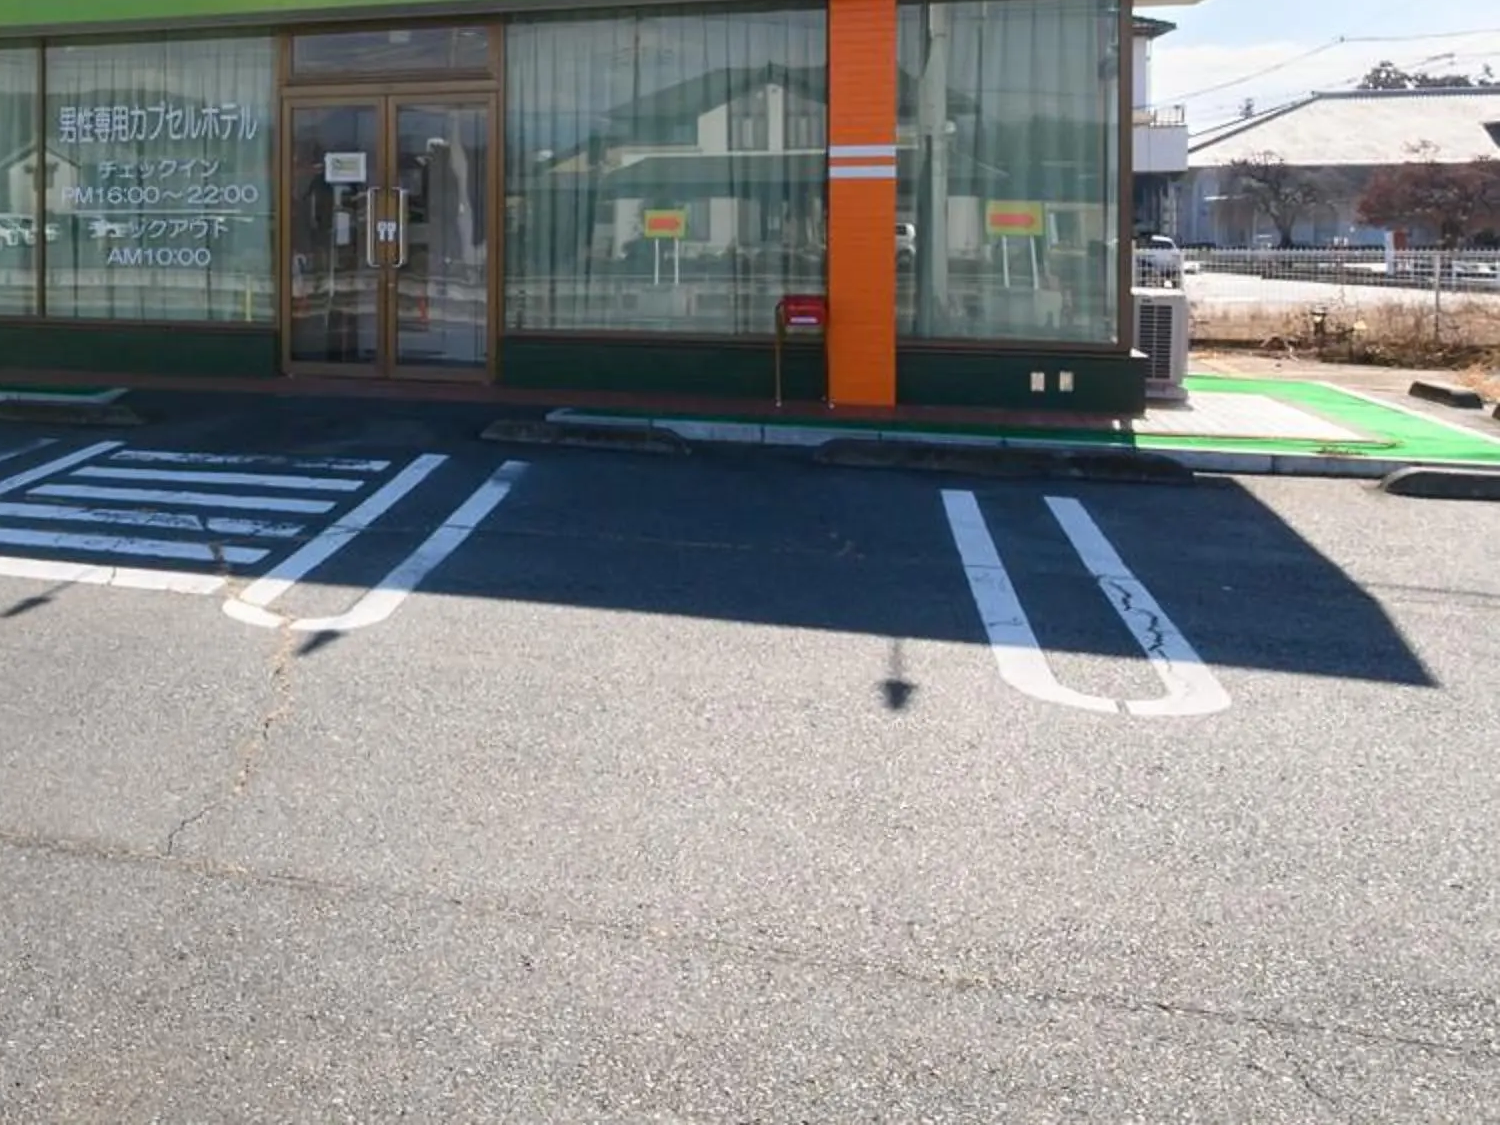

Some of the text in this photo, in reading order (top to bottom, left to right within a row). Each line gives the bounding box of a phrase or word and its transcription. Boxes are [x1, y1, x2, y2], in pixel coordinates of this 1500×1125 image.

[59, 101, 257, 143] 男性専用カプセルホテル
[99, 159, 219, 179] チェックイン
[107, 248, 211, 266] AM10:00
